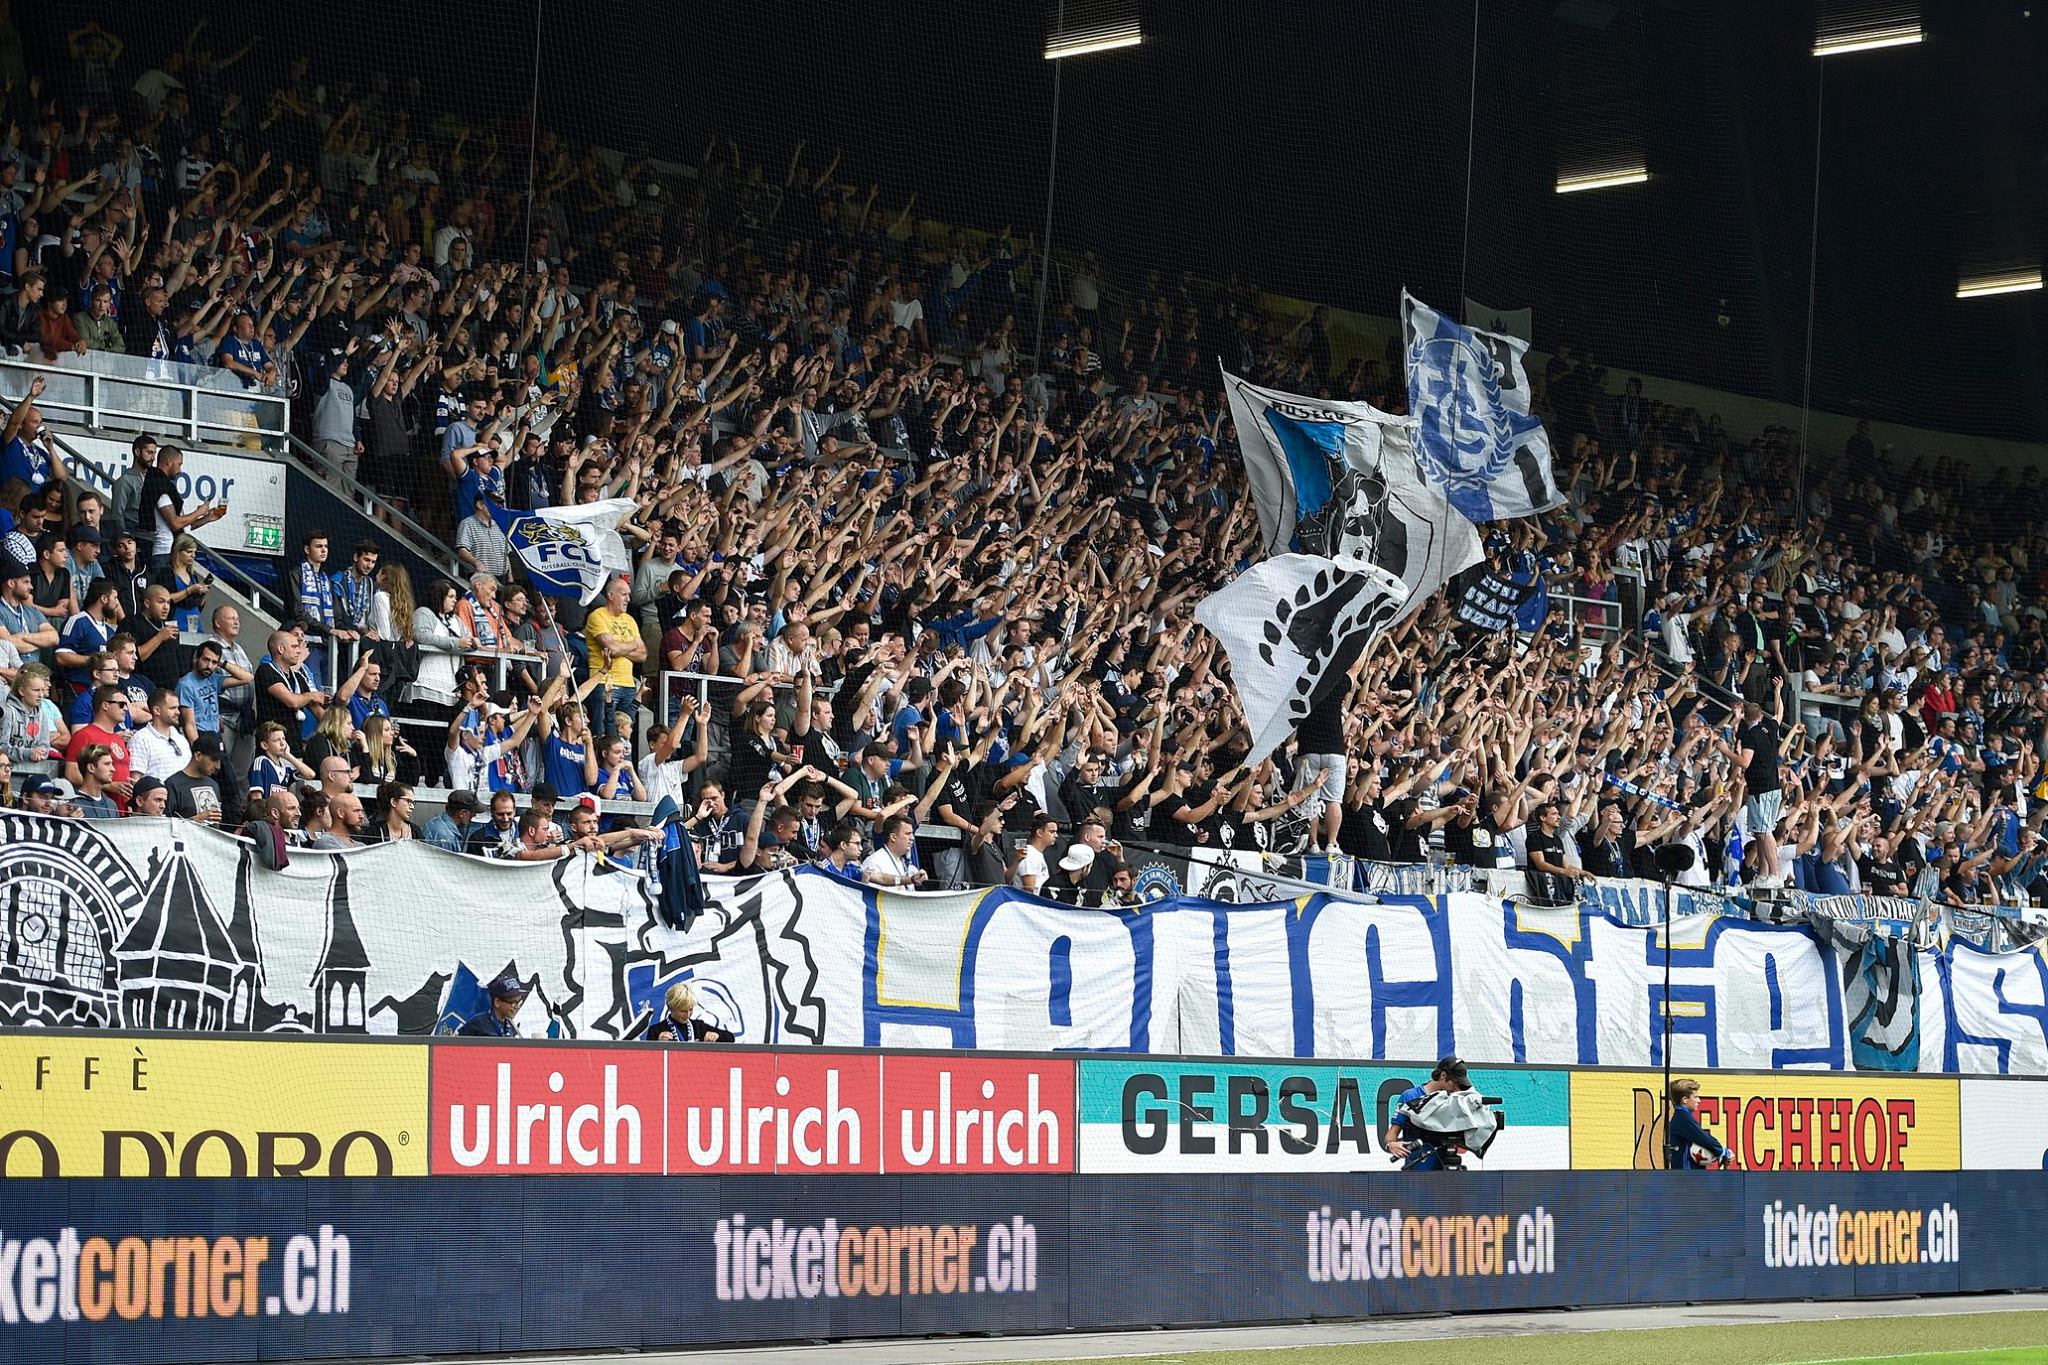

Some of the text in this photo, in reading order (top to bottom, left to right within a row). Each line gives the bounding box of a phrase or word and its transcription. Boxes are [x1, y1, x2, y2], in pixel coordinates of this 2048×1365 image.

[1458, 601, 1508, 631] UZERN
[0, 1045, 149, 1092] FFÈ
[449, 1061, 642, 1167] ulrich
[687, 1066, 861, 1167] ulrich
[901, 1070, 1060, 1166] ulrich
[714, 1213, 1038, 1301] ticketcorner.ch
[1305, 1204, 1556, 1284] ticketcorner.ch
[1762, 1199, 1961, 1270] ticketcorner.ch
